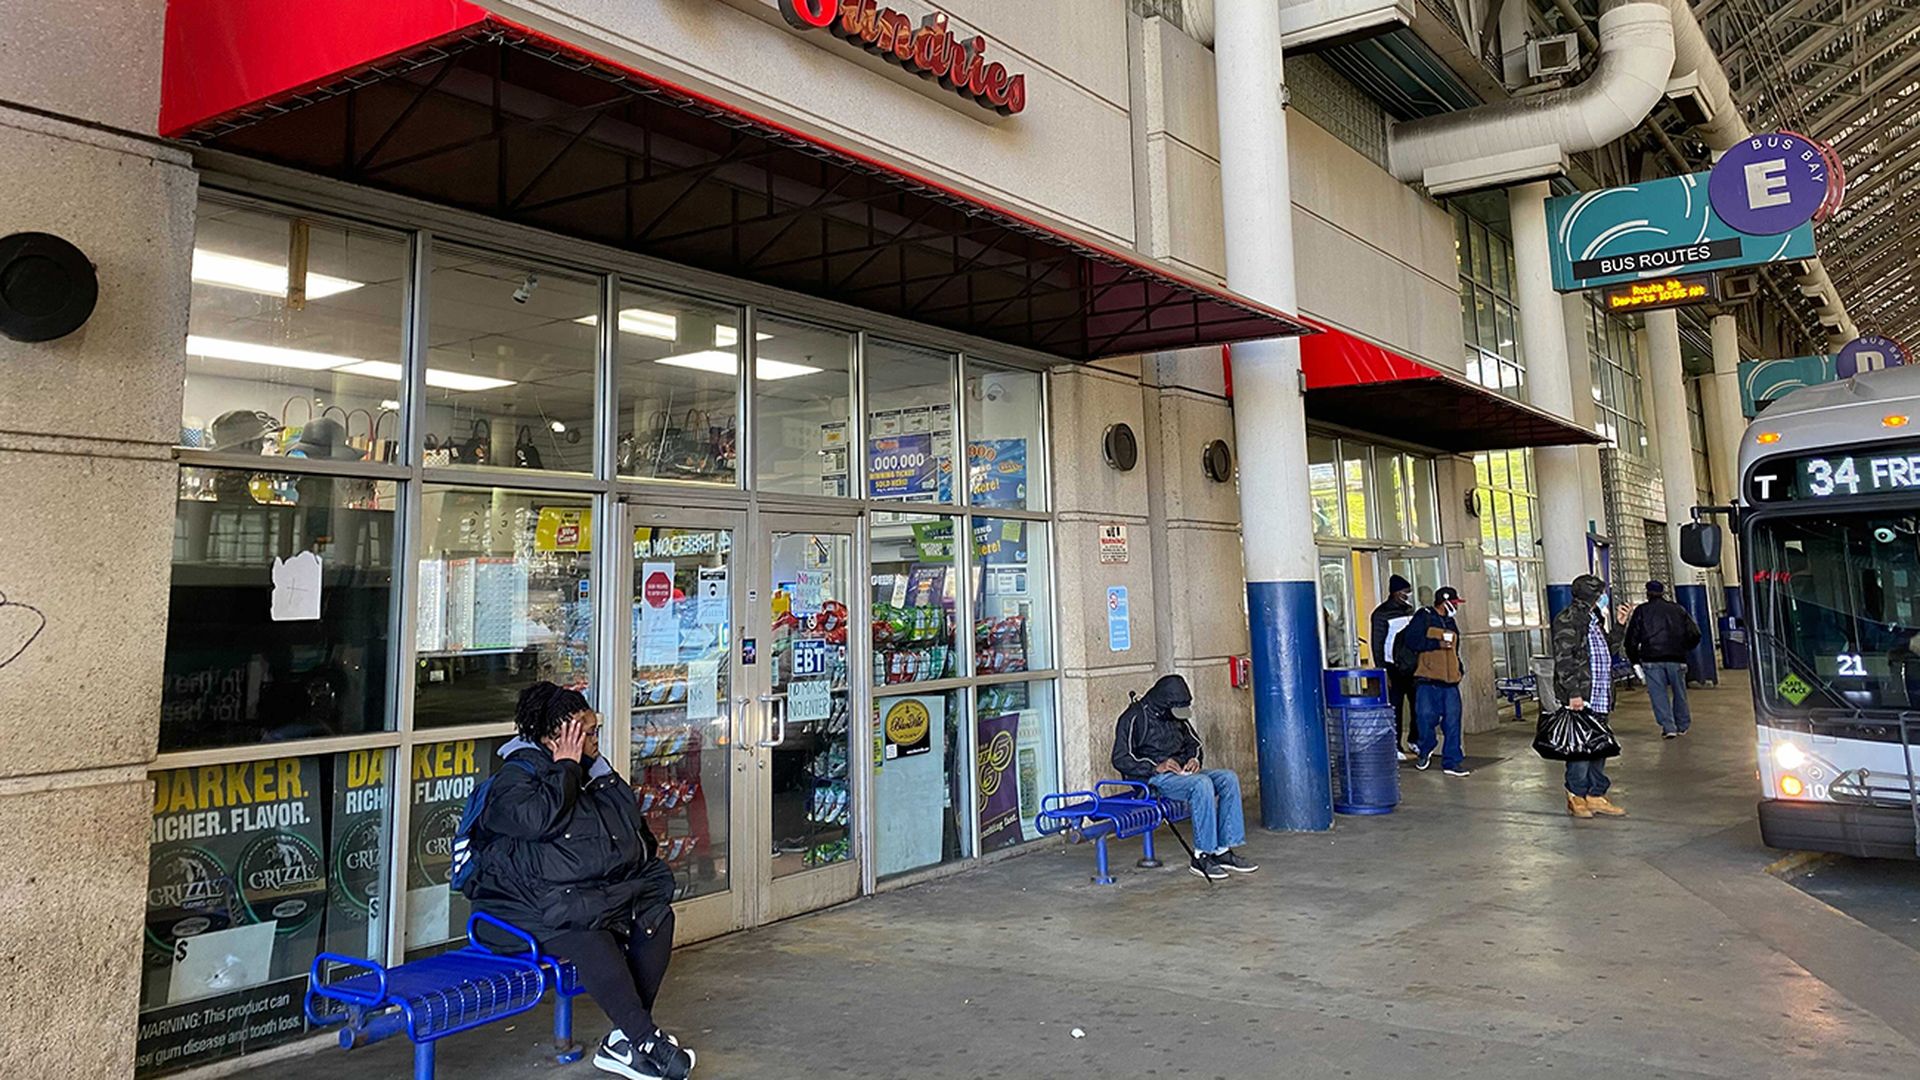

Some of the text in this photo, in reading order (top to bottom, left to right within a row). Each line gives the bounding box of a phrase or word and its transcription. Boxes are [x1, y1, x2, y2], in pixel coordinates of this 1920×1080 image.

[1751, 137, 1823, 183] BUS BAY
[1744, 158, 1791, 210] E
[1601, 246, 1711, 274] BUS ROUTES
[1860, 337, 1885, 346] BUS
[1754, 475, 1777, 499] T
[1807, 457, 1860, 496] 34
[794, 648, 824, 673] EBT
[1837, 654, 1867, 676] 21
[231, 801, 311, 833] FLAVOR.
[248, 863, 319, 890] GRIZZLY
[148, 878, 224, 907] GRIZZLY
[175, 940, 188, 963] $
[203, 1008, 226, 1025] This
[227, 1000, 269, 1022] product
[270, 994, 290, 1010] can
[155, 1045, 182, 1066] gum
[183, 1035, 226, 1056] disease
[227, 1028, 248, 1045] and
[250, 1020, 277, 1038] tooth
[278, 1015, 301, 1032] loss.
